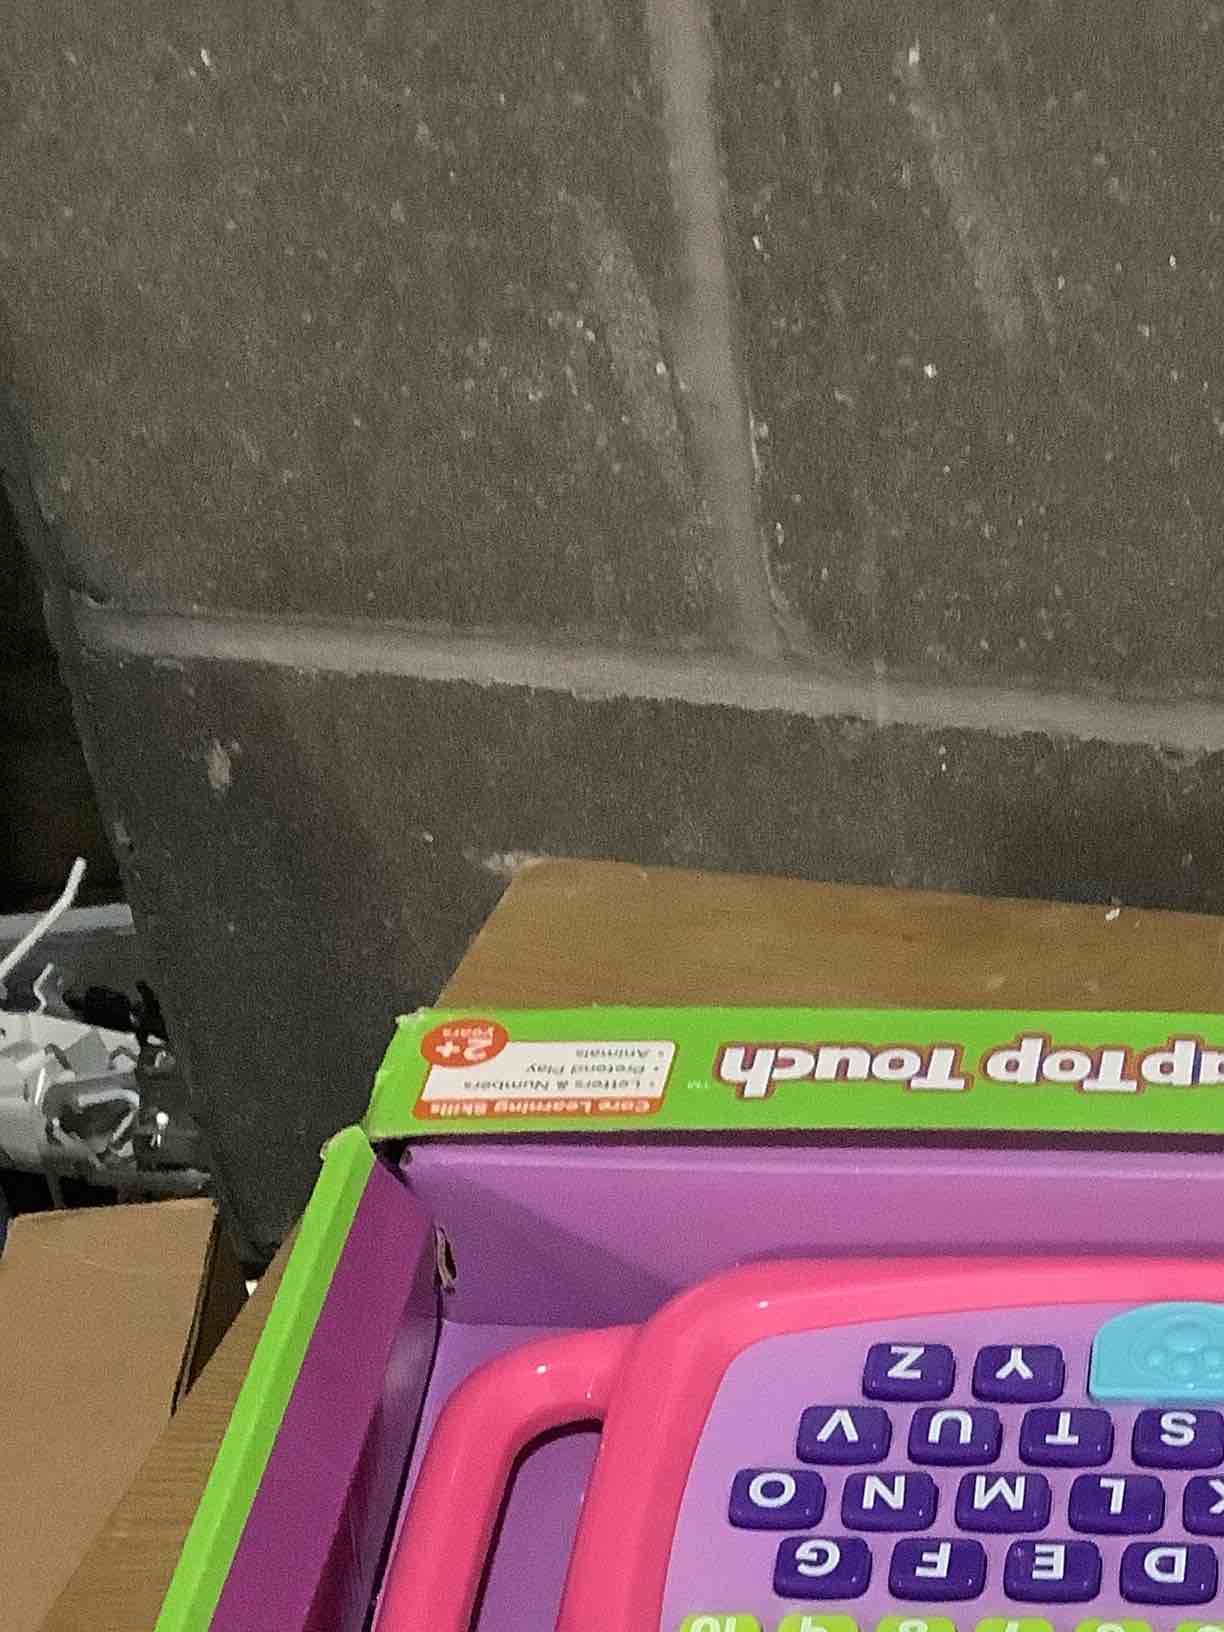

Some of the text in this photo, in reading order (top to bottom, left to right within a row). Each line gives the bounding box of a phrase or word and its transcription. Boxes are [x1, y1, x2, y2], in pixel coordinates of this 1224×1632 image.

[436, 1039, 493, 1060] 2+
[576, 1048, 650, 1059] Animals
[525, 1063, 566, 1075] Play
[717, 1048, 964, 1098] Touch
[463, 1080, 551, 1091] Numbers
[430, 1099, 650, 1116] Core Learning Skills
[888, 1347, 924, 1378] Z
[997, 1348, 1033, 1378] Y
[817, 1410, 858, 1441] V
[928, 1410, 972, 1443] U
[1046, 1412, 1078, 1444] T
[1161, 1412, 1196, 1445] S
[750, 1472, 795, 1507] O
[863, 1476, 905, 1508] N
[974, 1476, 1025, 1509] M
[1101, 1479, 1125, 1513] L
[796, 1540, 840, 1576] G
[916, 1543, 951, 1577] F
[1033, 1545, 1064, 1579] E
[1145, 1548, 1186, 1582] D
